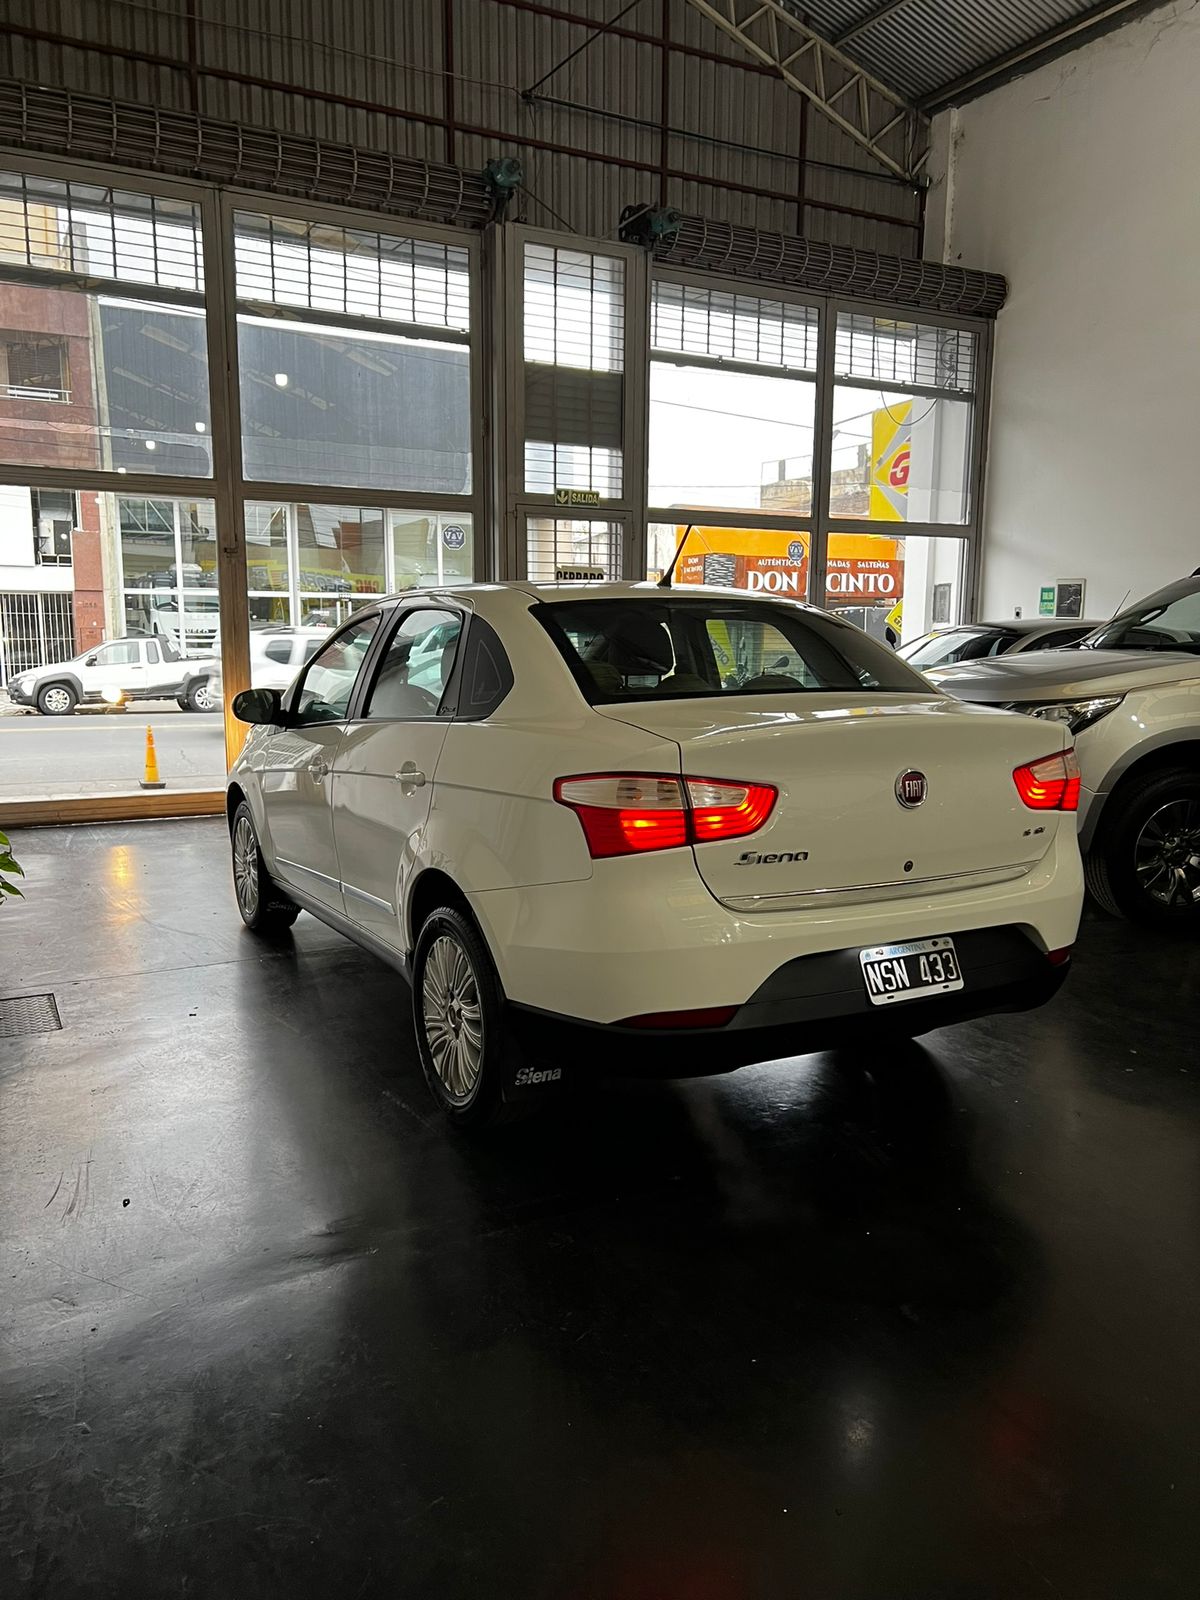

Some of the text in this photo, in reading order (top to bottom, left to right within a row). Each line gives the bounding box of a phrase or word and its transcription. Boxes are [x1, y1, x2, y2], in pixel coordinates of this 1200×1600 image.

[572, 493, 599, 503] SALIDA
[857, 560, 889, 569] SALTEÑAS
[747, 571, 895, 595] DON CINTO
[905, 780, 921, 797] FIAT
[733, 851, 809, 866] Siena
[888, 943, 926, 955] ARGENTINA
[866, 951, 958, 993] NSN 433
[515, 1066, 562, 1086] Siena
